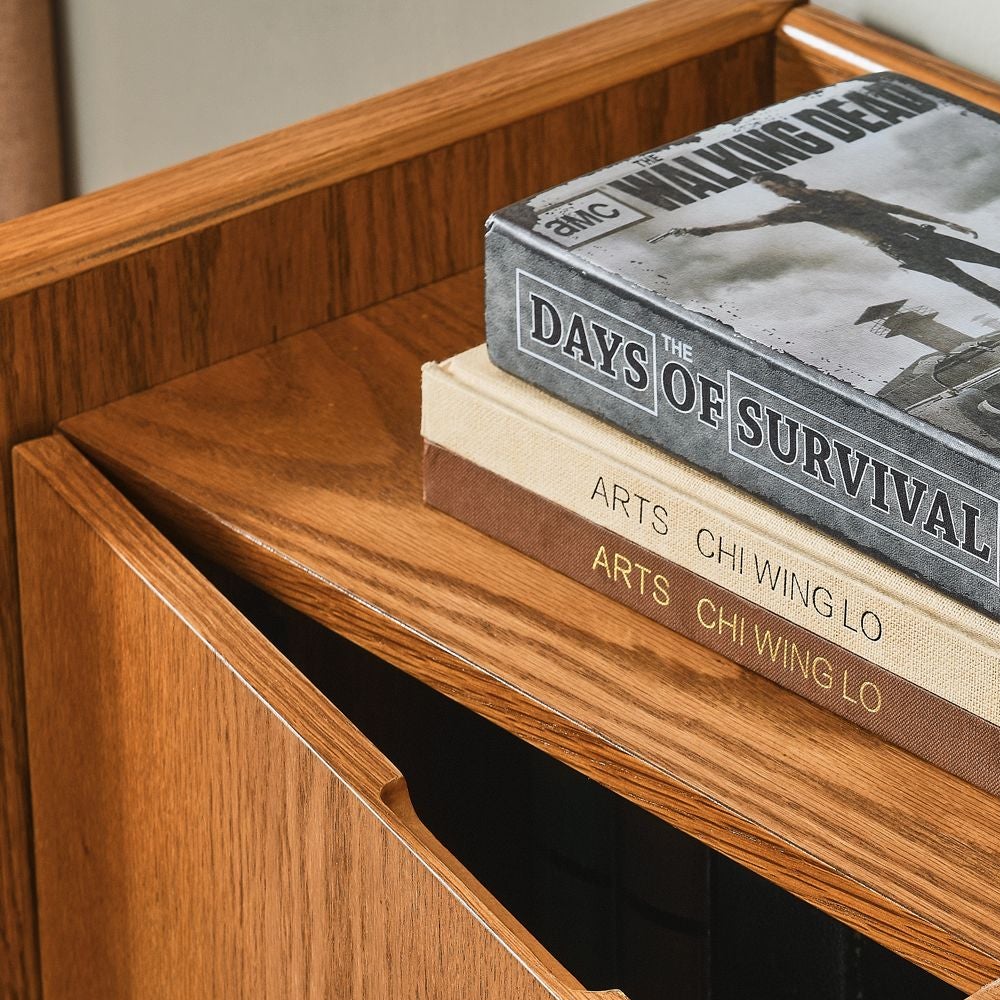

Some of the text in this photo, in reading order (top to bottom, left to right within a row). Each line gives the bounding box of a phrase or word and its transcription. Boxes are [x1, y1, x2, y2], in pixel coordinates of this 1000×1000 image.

[609, 80, 938, 211] WALKING DEAD
[633, 153, 663, 167] THE
[661, 333, 693, 362] THE
[530, 293, 992, 562] DAYS OF SURVIVAL
[590, 476, 883, 643] ARTS CHI WING LO
[592, 545, 883, 714] ARTS CHI WING LO
